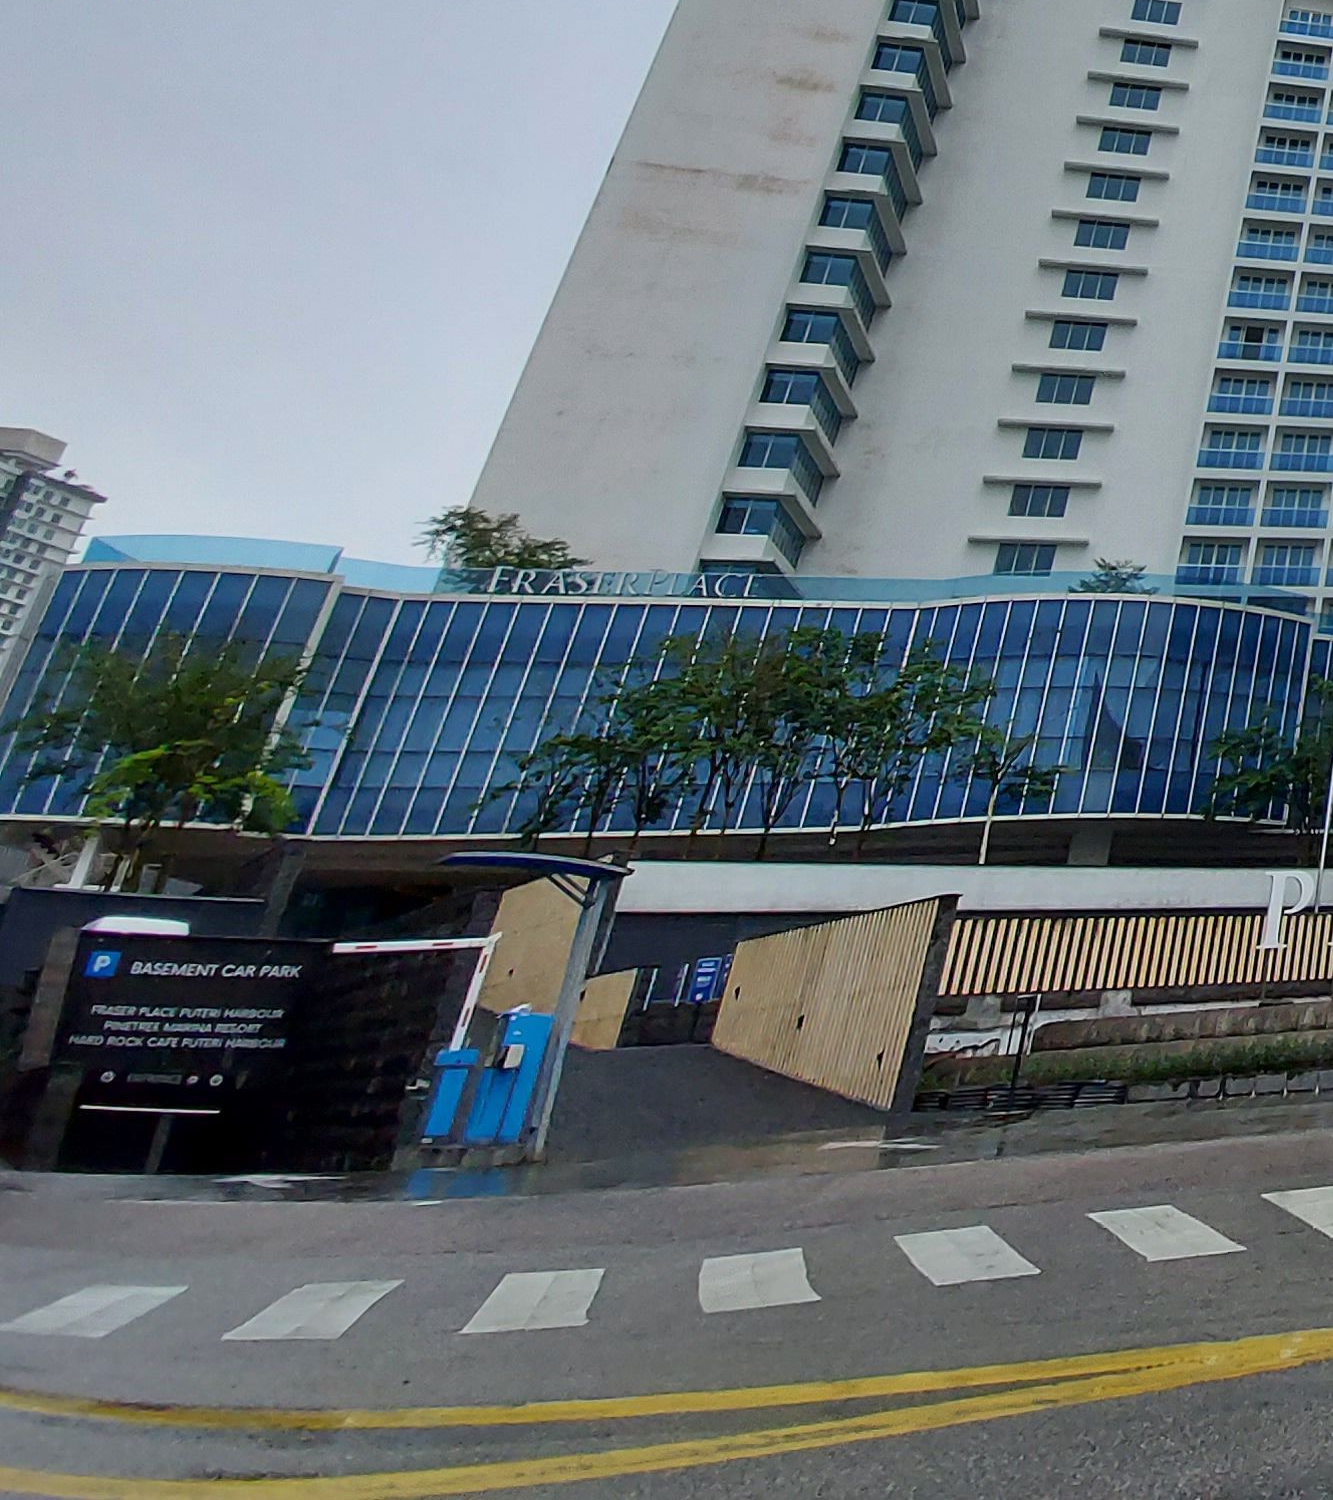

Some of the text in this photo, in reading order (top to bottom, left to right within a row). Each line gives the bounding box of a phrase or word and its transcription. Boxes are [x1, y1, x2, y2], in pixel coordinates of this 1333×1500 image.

[93, 955, 303, 979] P BASEMENT CAR PARK
[138, 1007, 177, 1019] PLACE
